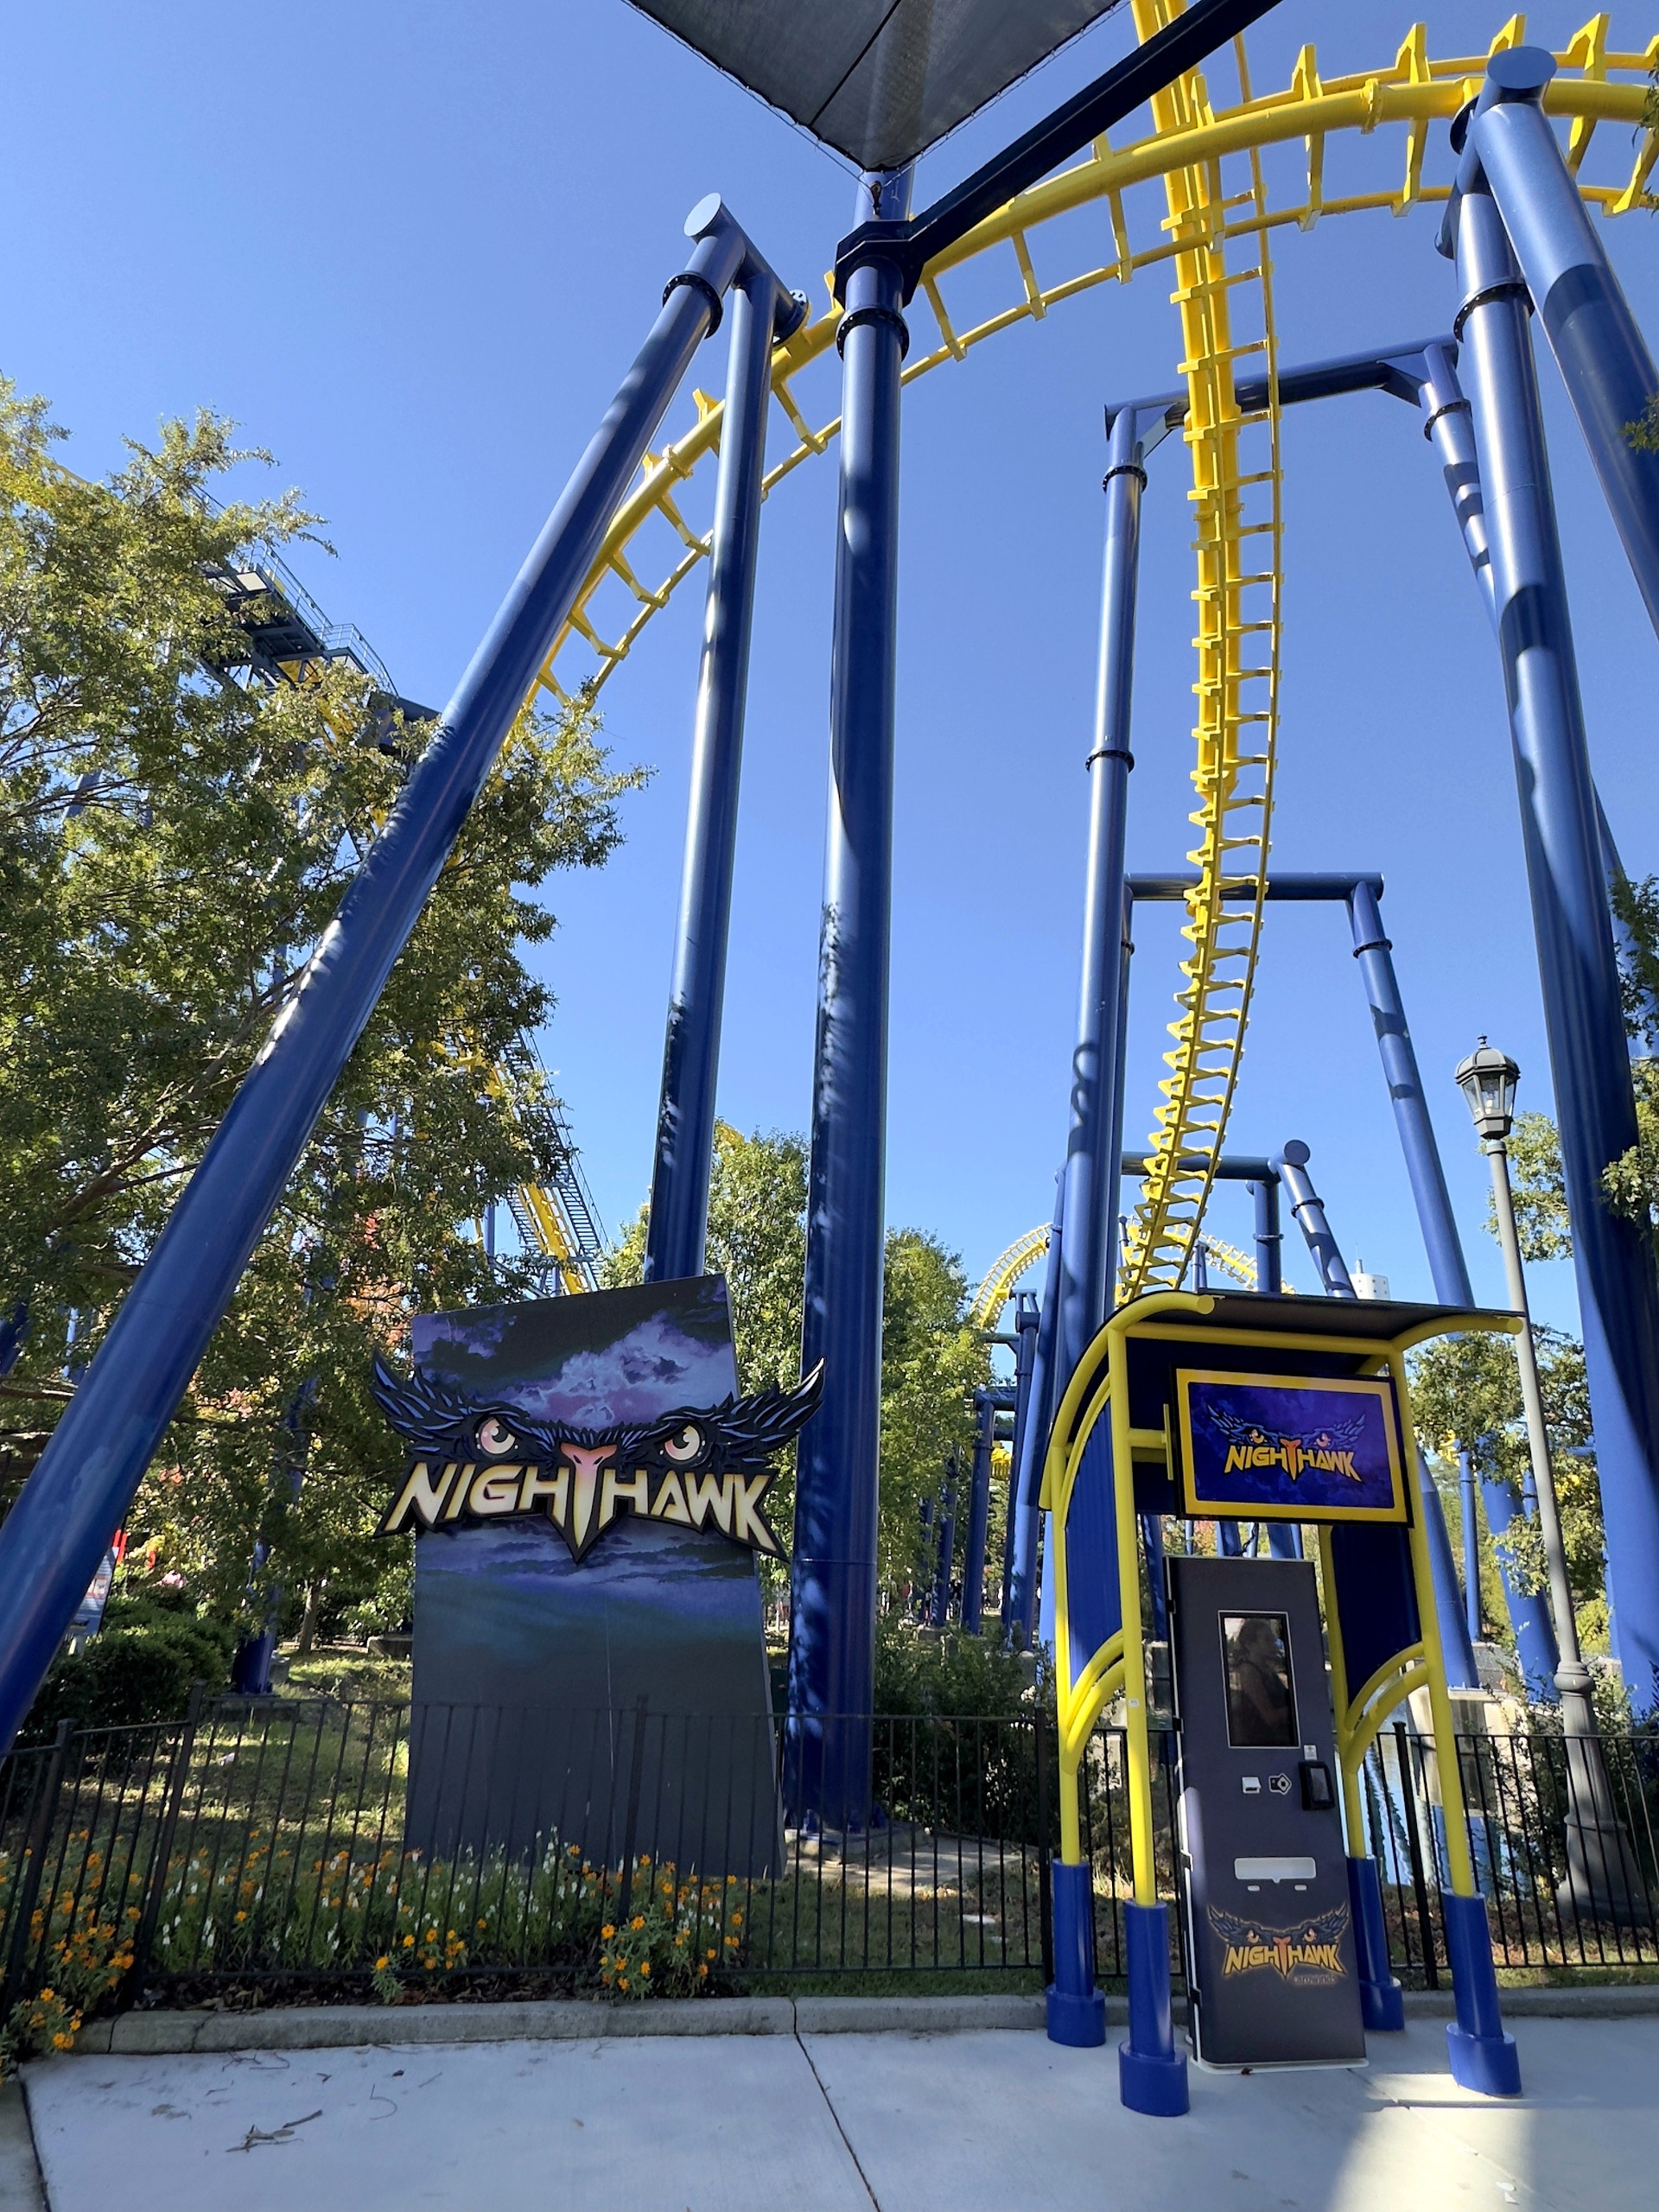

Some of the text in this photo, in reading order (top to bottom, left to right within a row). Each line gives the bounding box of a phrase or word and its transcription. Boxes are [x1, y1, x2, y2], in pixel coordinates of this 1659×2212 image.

[1224, 1440, 1361, 1481] NIGHTHAWK
[385, 1445, 778, 1552] NIGHTHAWK
[1224, 1937, 1344, 1975] NIGHTHAWK
